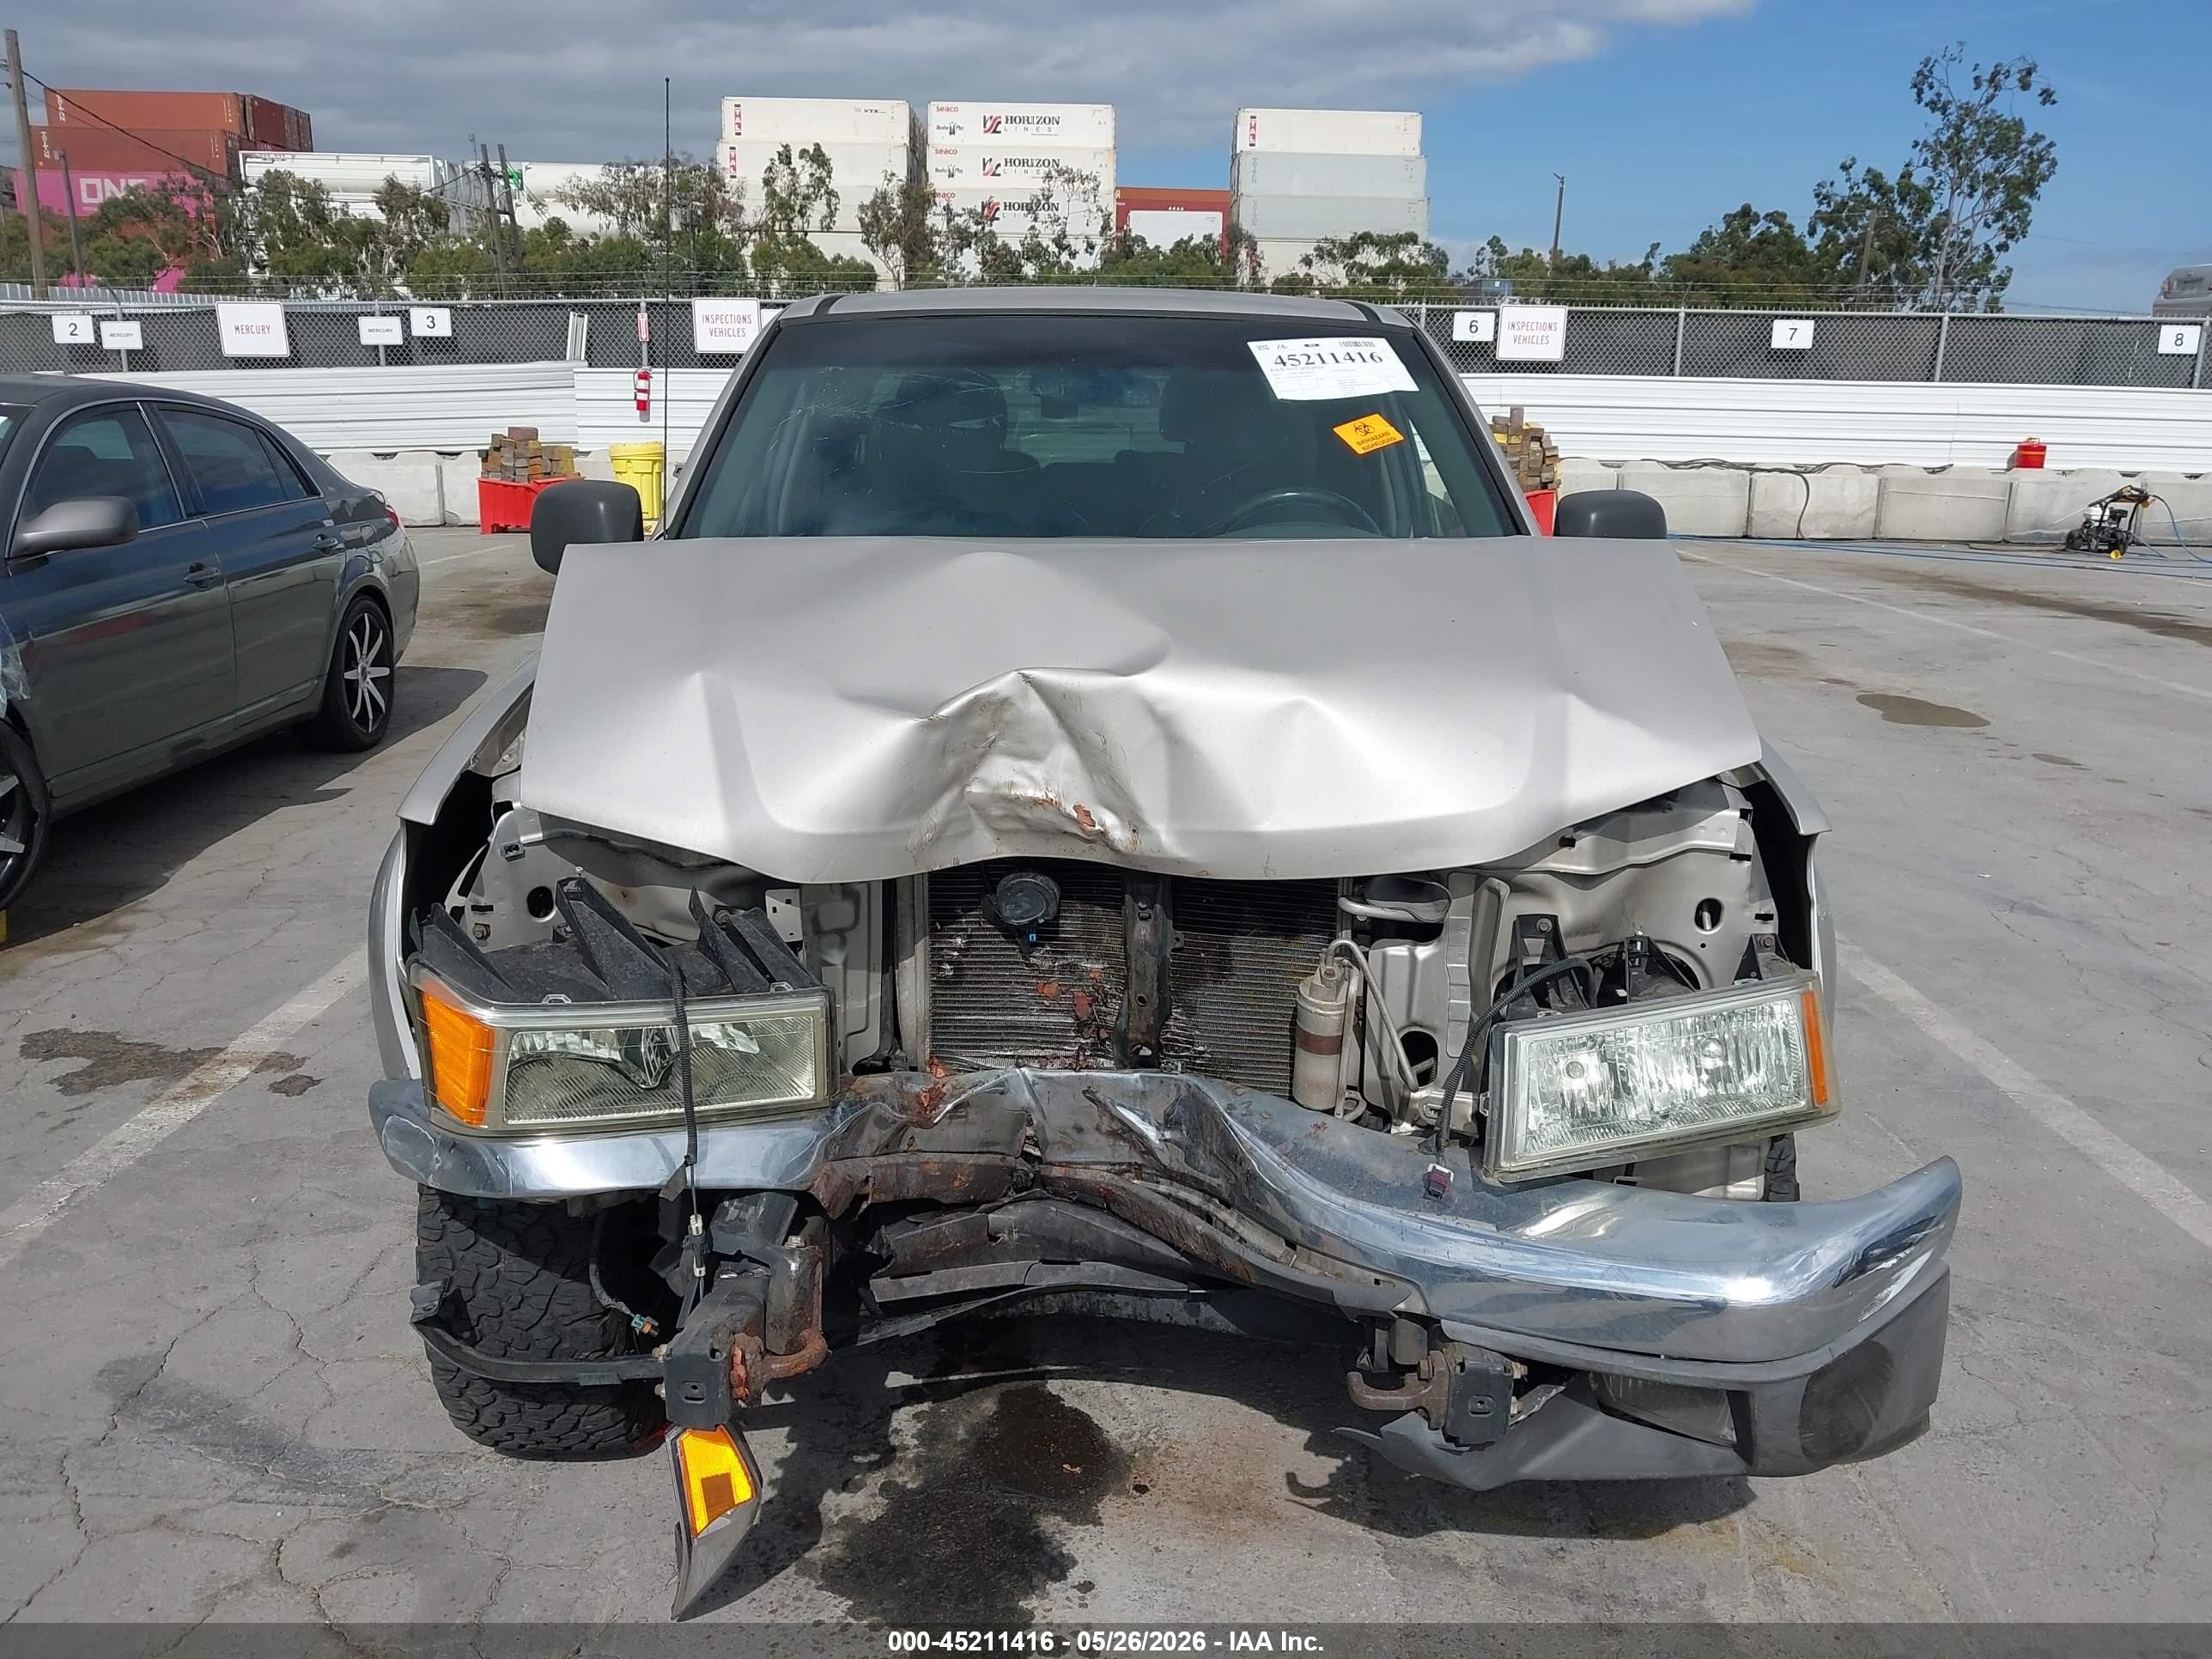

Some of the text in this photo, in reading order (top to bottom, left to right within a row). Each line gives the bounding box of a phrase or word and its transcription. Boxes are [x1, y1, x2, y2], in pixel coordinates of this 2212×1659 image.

[1005, 115, 1060, 125] HORIZON
[1003, 158, 1060, 168] HORIZON
[426, 315, 436, 329] 3
[702, 313, 752, 325] INSPECTIONS
[68, 322, 78, 337] 2
[234, 324, 271, 335] MERCURY
[708, 327, 746, 337] VEHICLES
[1468, 319, 1479, 334] 6
[1507, 321, 1559, 331] INSPECTIONS
[1513, 335, 1550, 345] VEHICLES
[1788, 327, 1798, 341] 7
[2174, 332, 2185, 347] 8
[1273, 351, 1383, 368] 45211416
[1356, 431, 1391, 447] BIOHAZARD
